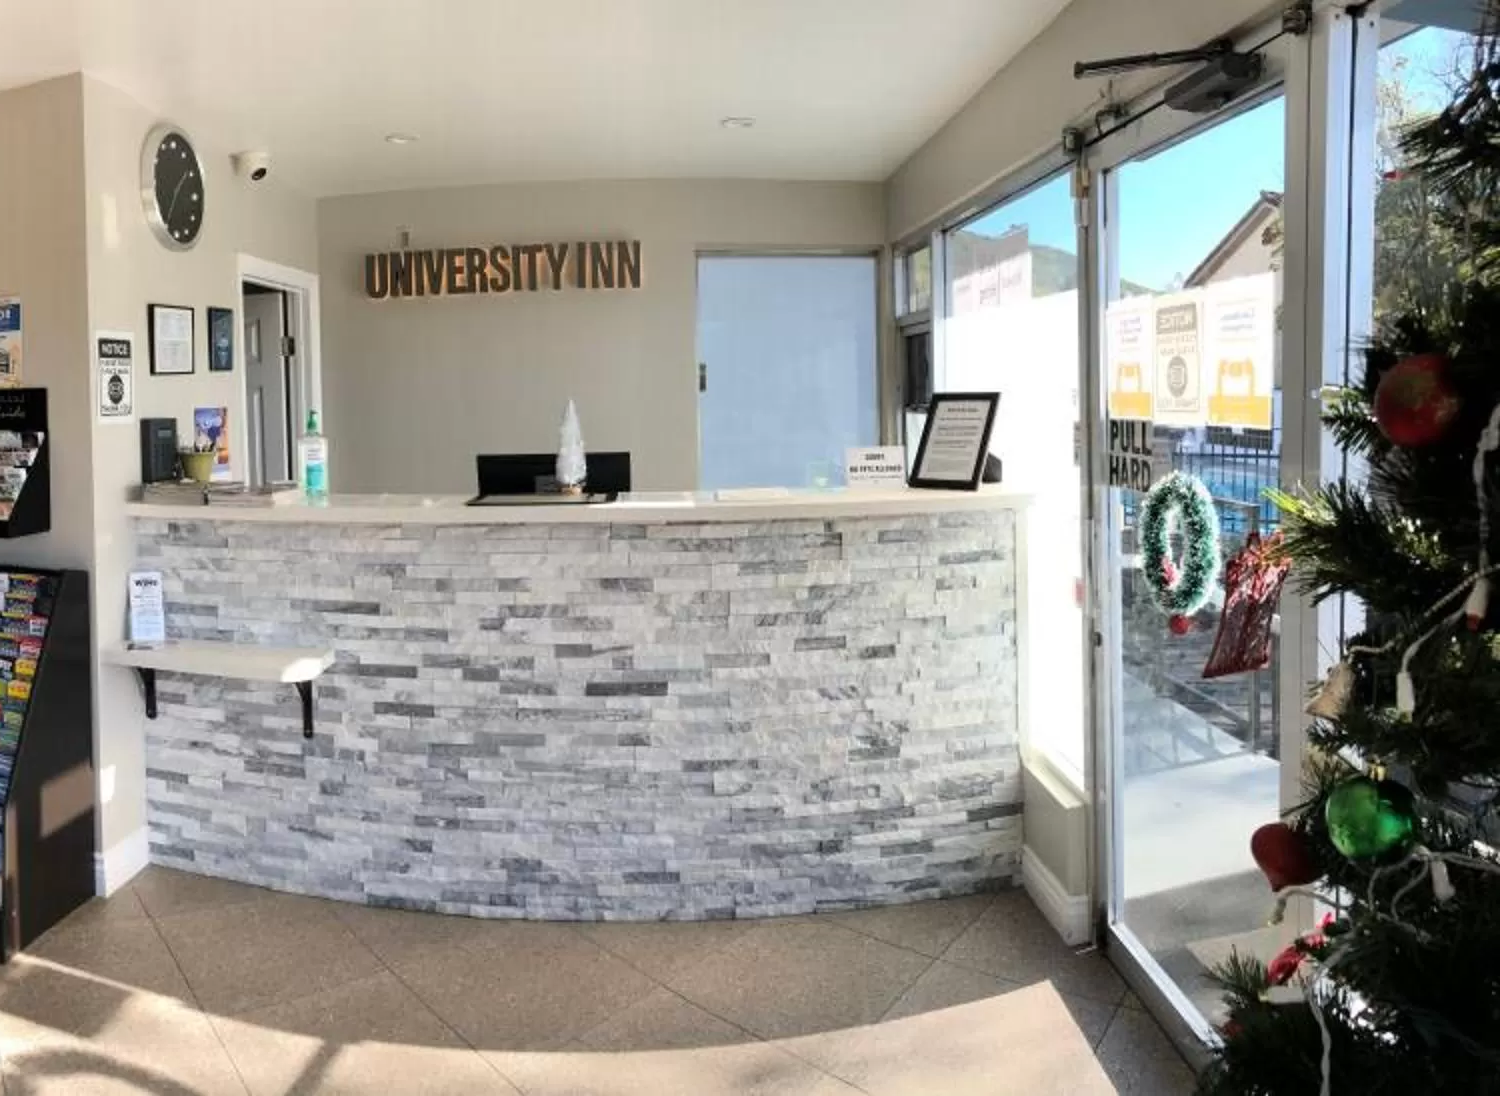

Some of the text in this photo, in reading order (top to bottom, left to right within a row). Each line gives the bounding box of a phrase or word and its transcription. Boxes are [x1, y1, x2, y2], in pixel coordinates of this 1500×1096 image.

[365, 240, 641, 299] UNIVERSITY INN
[1109, 419, 1152, 456] PULL
[1109, 454, 1151, 493] HARD
